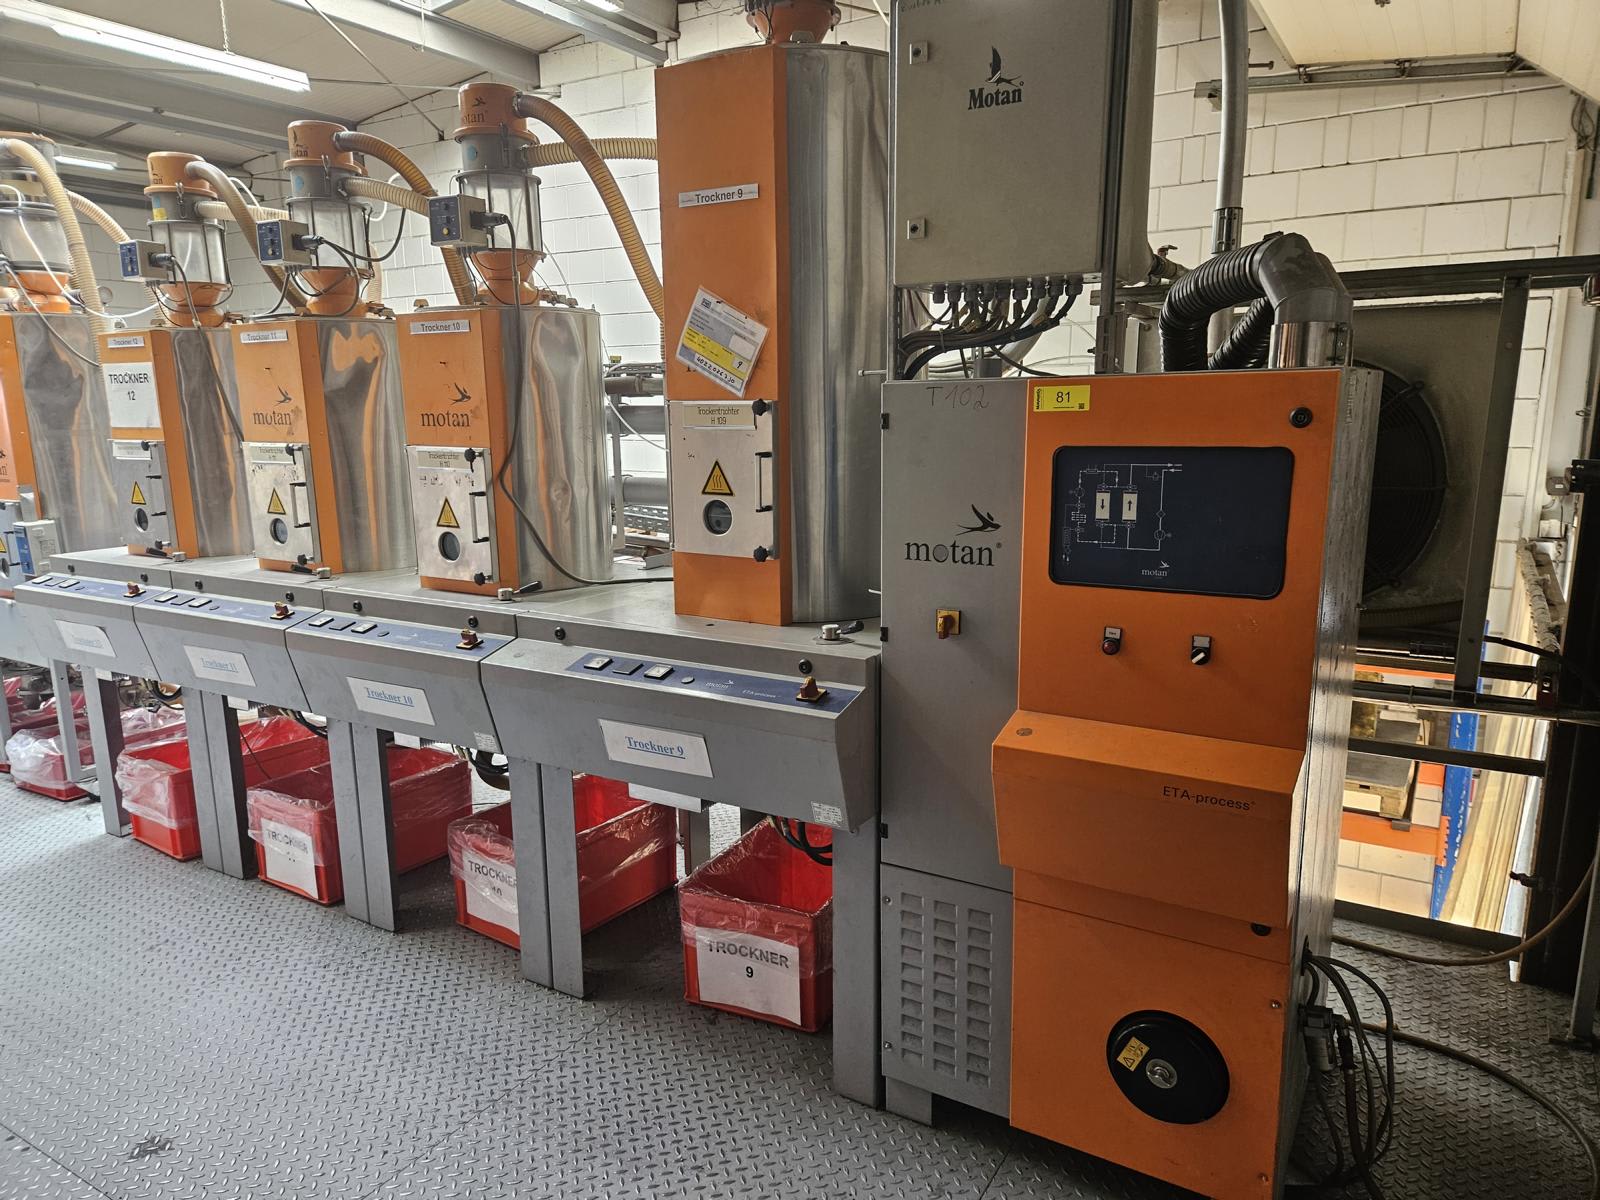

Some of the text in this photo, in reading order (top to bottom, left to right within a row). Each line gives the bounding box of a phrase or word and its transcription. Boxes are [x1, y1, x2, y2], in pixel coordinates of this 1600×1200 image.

[968, 87, 1022, 110] Motan
[695, 188, 743, 203] Trockner 9
[420, 321, 460, 333] Trockner 10
[108, 372, 149, 384] TROCKNER
[127, 390, 136, 400] 12
[1056, 391, 1071, 403] 81
[253, 410, 292, 425] motan
[421, 410, 470, 427] motan
[904, 540, 995, 566] motan
[1141, 568, 1168, 577] motan
[364, 686, 413, 705] Trockner 10
[625, 735, 684, 756] Trockner 9
[1163, 785, 1251, 811] ETA-process
[708, 939, 789, 969] TROCKNER
[745, 966, 754, 978] 9
